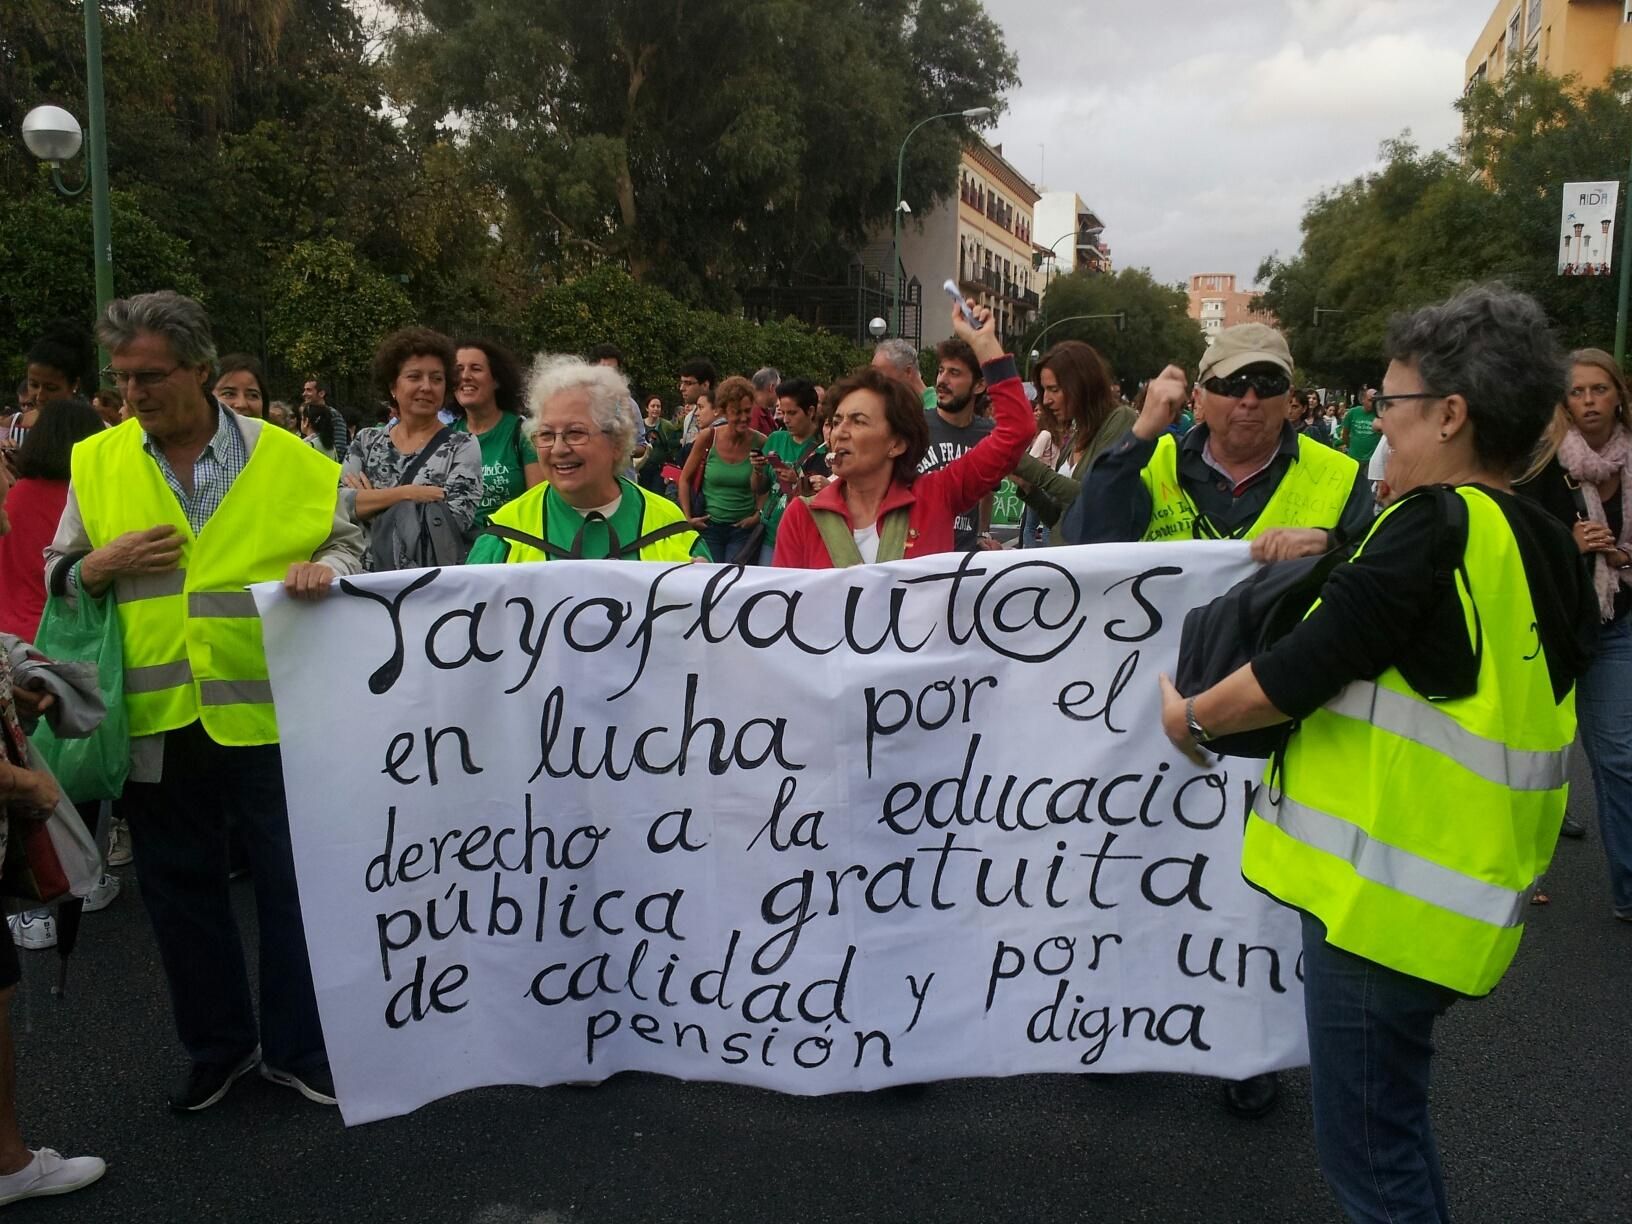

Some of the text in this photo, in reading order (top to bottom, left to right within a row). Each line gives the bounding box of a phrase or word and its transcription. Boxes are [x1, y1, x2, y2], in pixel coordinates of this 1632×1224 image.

[916, 445, 938, 474] SAN
[340, 552, 1184, 702] Yayoflaut@s
[381, 650, 1141, 786] en lucha por el
[365, 792, 611, 893] derecho
[647, 808, 711, 854] a
[747, 775, 829, 852] la
[376, 832, 1213, 982] pública gratuita
[385, 930, 1305, 1032] de calidad y por un
[587, 979, 1212, 1069] pensión digna
